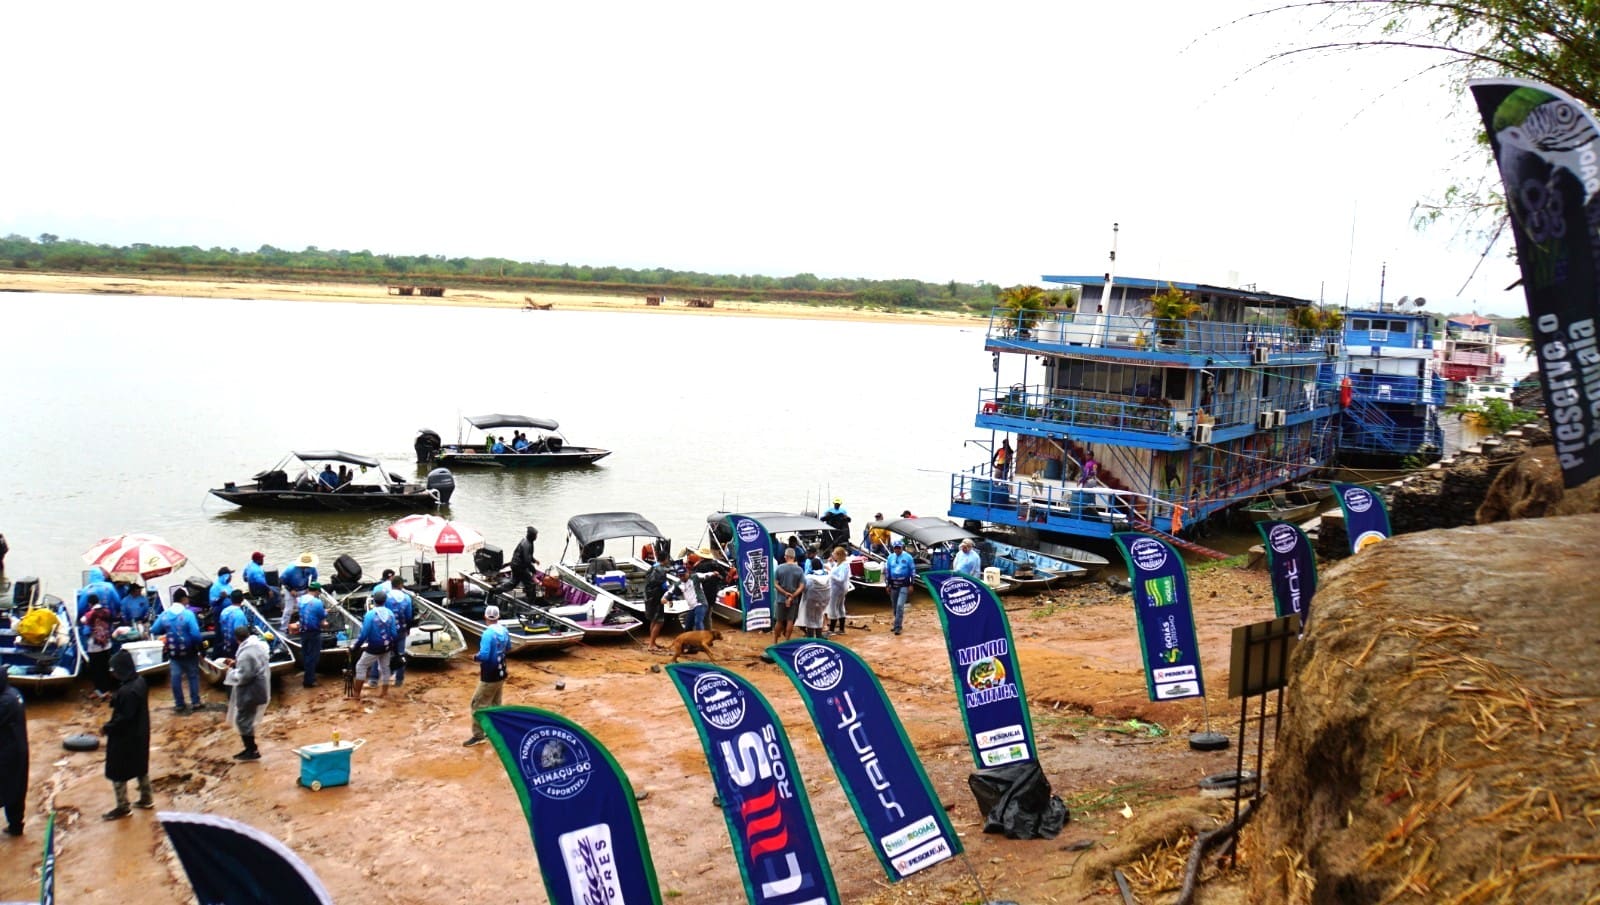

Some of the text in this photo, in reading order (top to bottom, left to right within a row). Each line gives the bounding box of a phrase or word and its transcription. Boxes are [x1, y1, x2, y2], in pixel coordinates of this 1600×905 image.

[1538, 313, 1585, 470] Preserve o
[952, 600, 976, 613] ARAGUAIA
[798, 648, 825, 665] CIRCUITO
[958, 637, 1008, 665] MUNDO
[807, 660, 836, 679] GIGANTES
[812, 668, 840, 687] ARAGUAIA
[697, 680, 728, 695] CIRCUITO
[706, 697, 738, 713] GIGANTES
[711, 707, 741, 725] ARAGUAIA
[522, 729, 577, 760] TORNEIO DE PESCA
[762, 723, 793, 800] RODS
[532, 762, 592, 787] MINAÇU-GO
[546, 778, 585, 795] ESPORTIVA
